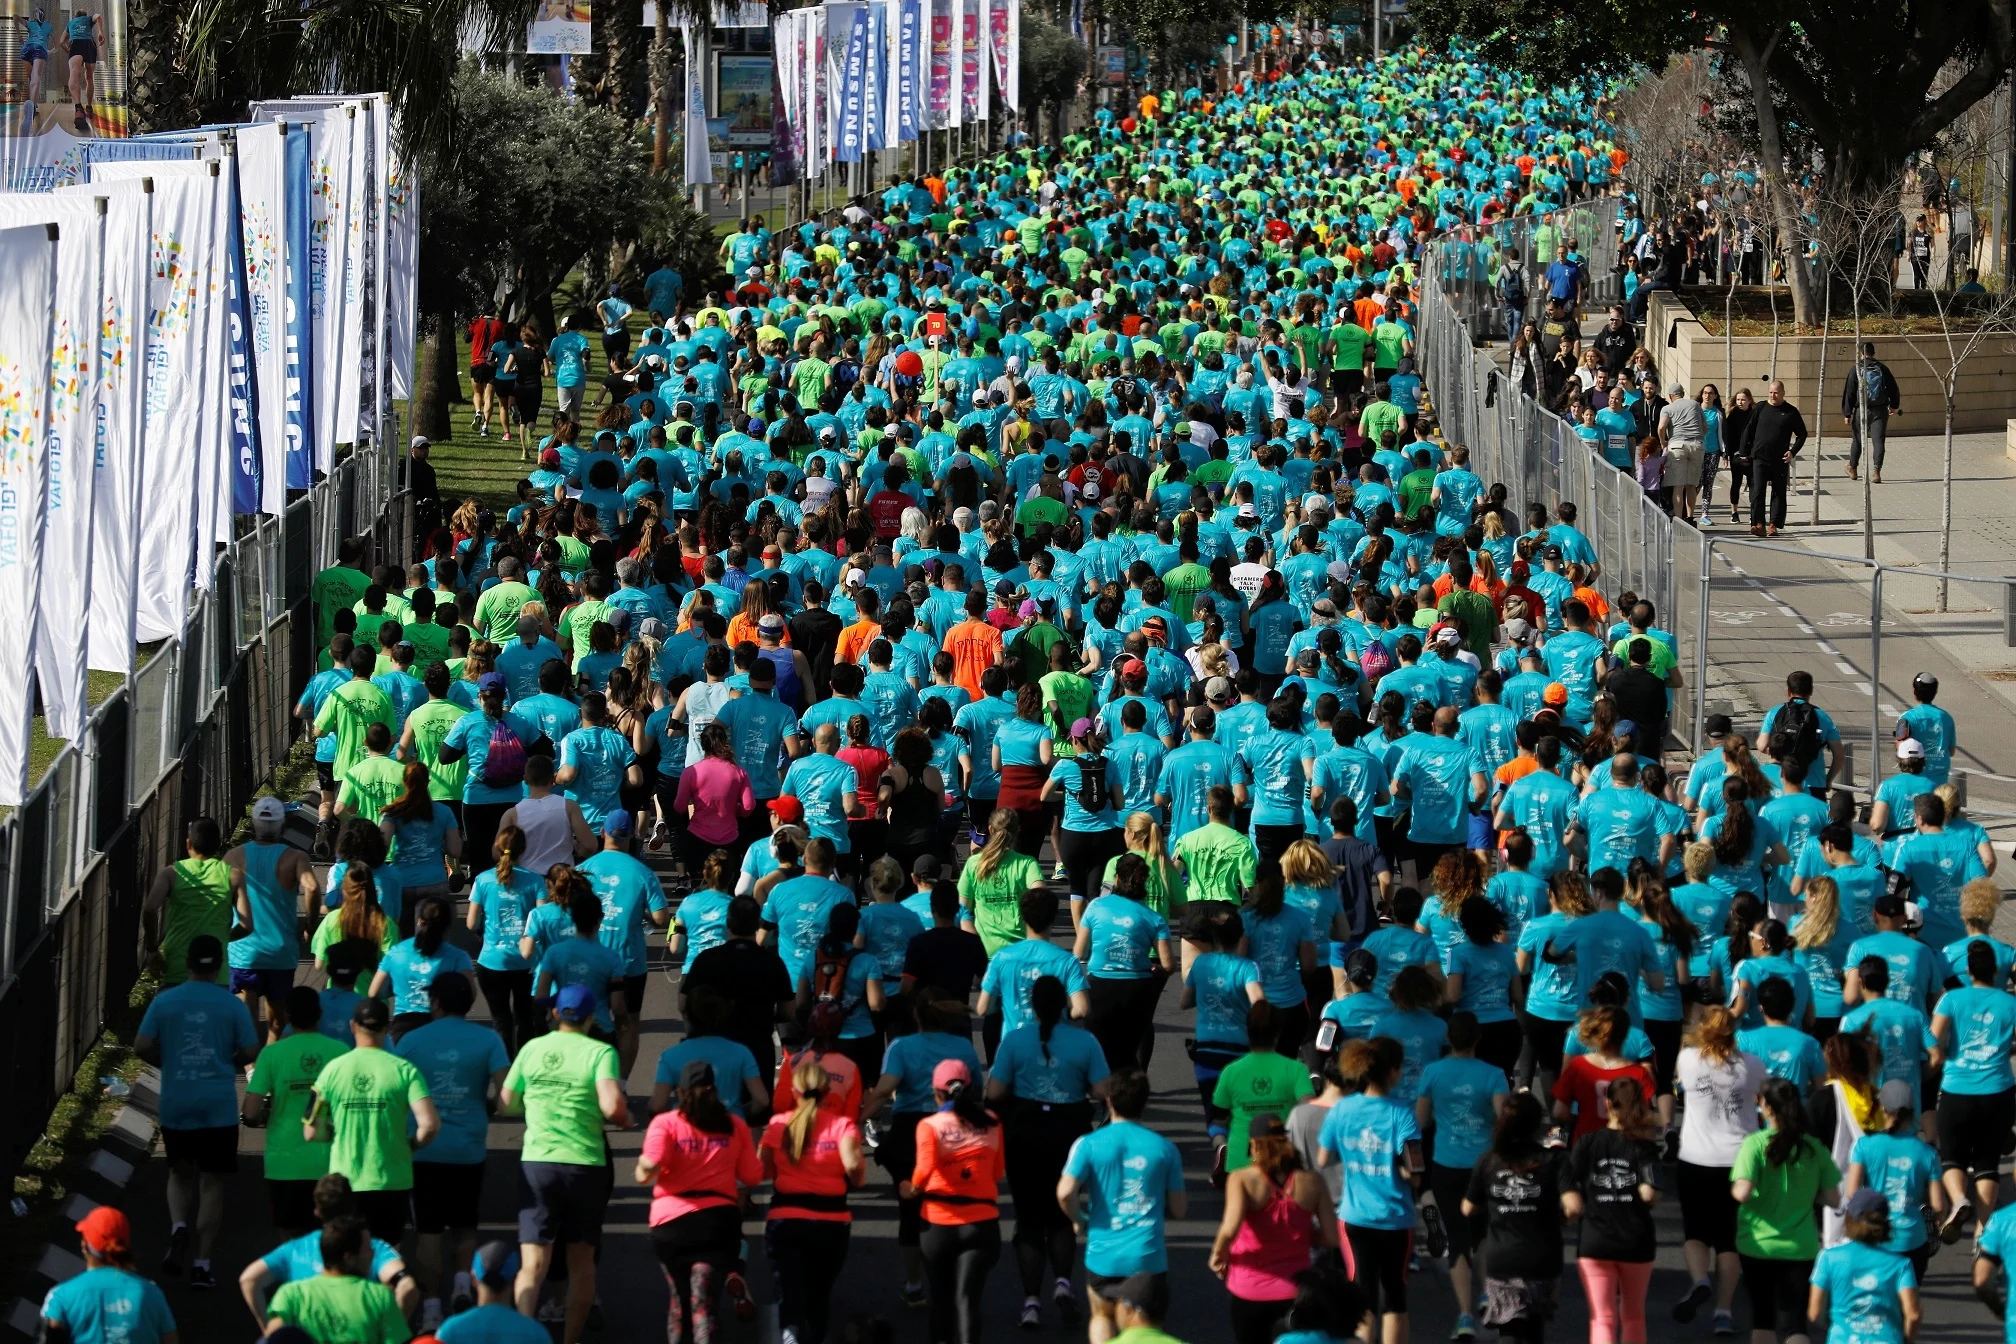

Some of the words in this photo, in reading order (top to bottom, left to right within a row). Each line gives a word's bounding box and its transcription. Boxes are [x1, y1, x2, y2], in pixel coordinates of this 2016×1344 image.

[844, 23, 863, 147] SAMSUNG
[901, 12, 914, 126] SAMSUNG
[931, 321, 941, 329] 70
[156, 344, 169, 369] יפו
[153, 370, 169, 414] YAFO
[49, 429, 61, 456] יפו
[1, 482, 16, 511] יפו
[50, 460, 62, 510] YAFO
[0, 515, 17, 568] YAFO
[420, 719, 436, 730] אביב
